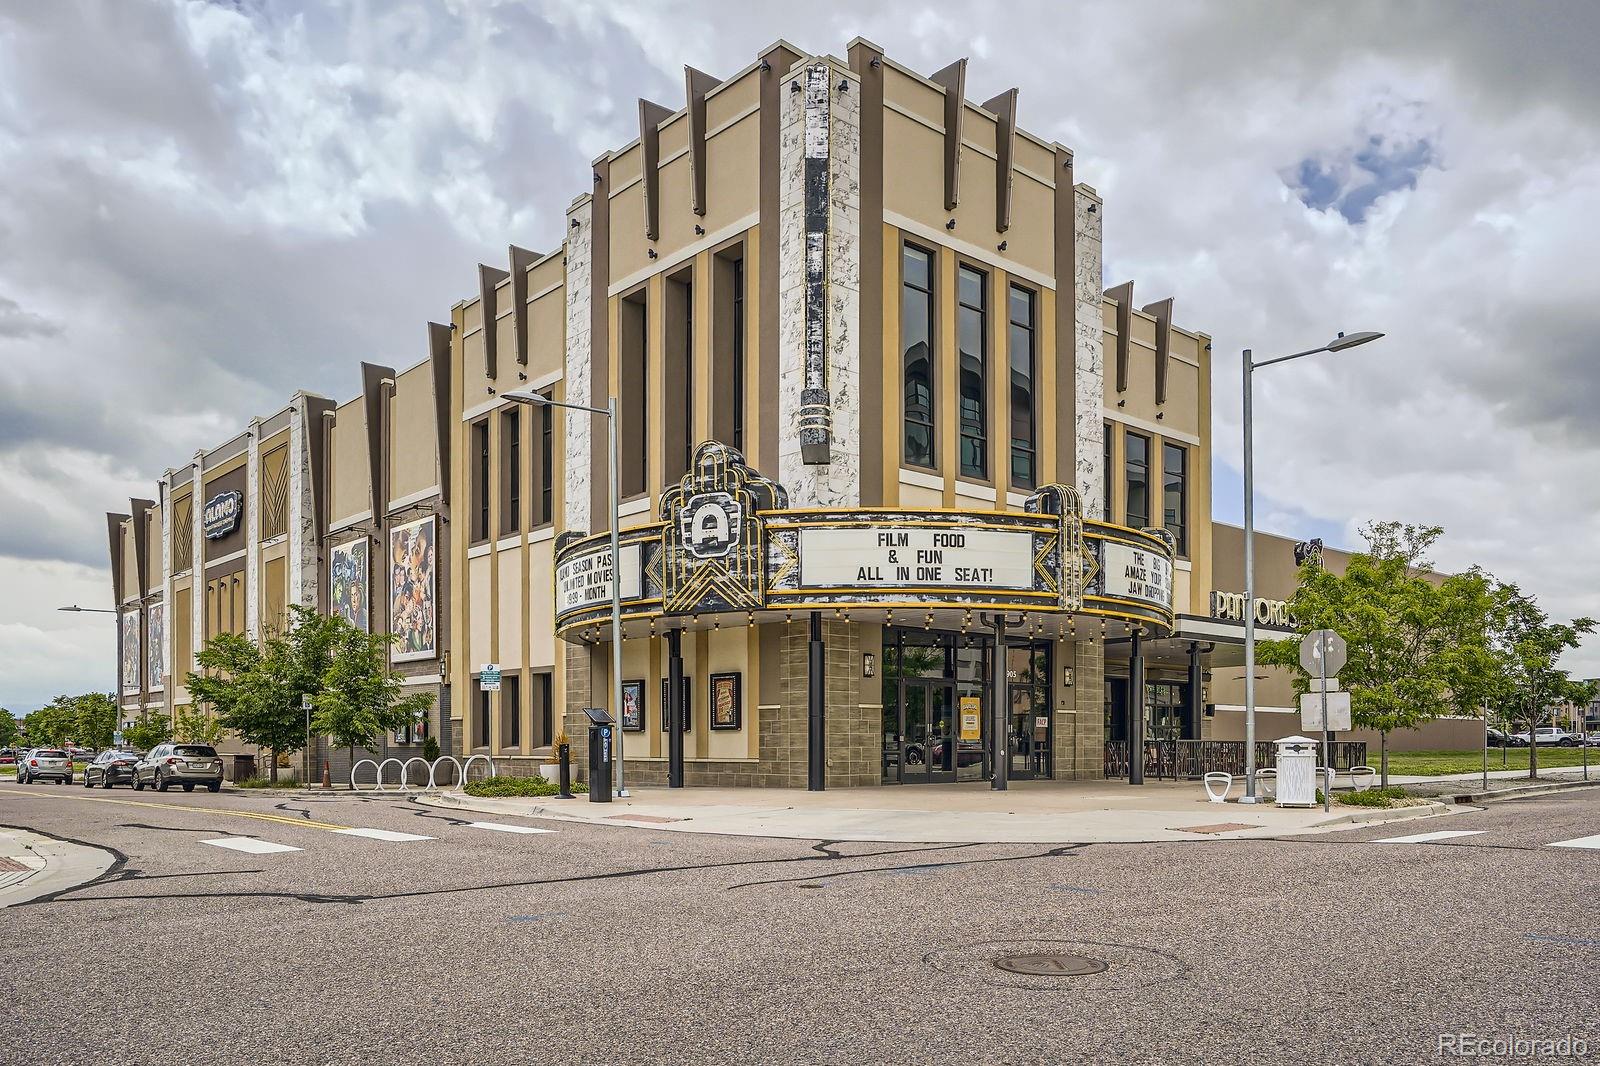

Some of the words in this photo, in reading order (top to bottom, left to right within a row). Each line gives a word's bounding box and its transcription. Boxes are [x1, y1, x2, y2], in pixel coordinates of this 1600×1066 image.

[692, 503, 729, 545] A
[877, 532, 909, 547] FILM
[933, 533, 966, 548] FOOD
[572, 557, 593, 576] SEASON
[597, 553, 612, 569] PAS
[888, 550, 899, 564] &
[917, 550, 943, 564] FUN
[1133, 551, 1145, 566] THE
[586, 568, 613, 586] MOVIES
[857, 566, 884, 581] ALL
[896, 566, 910, 581] IN
[916, 566, 942, 581] ONE
[955, 567, 993, 583] SEAT!
[1124, 565, 1147, 582] AMAZE
[1151, 570, 1162, 587] YOUR
[585, 585, 606, 601] MONTH
[1128, 580, 1143, 596] JAW
[1214, 590, 1298, 628] PANORAS
